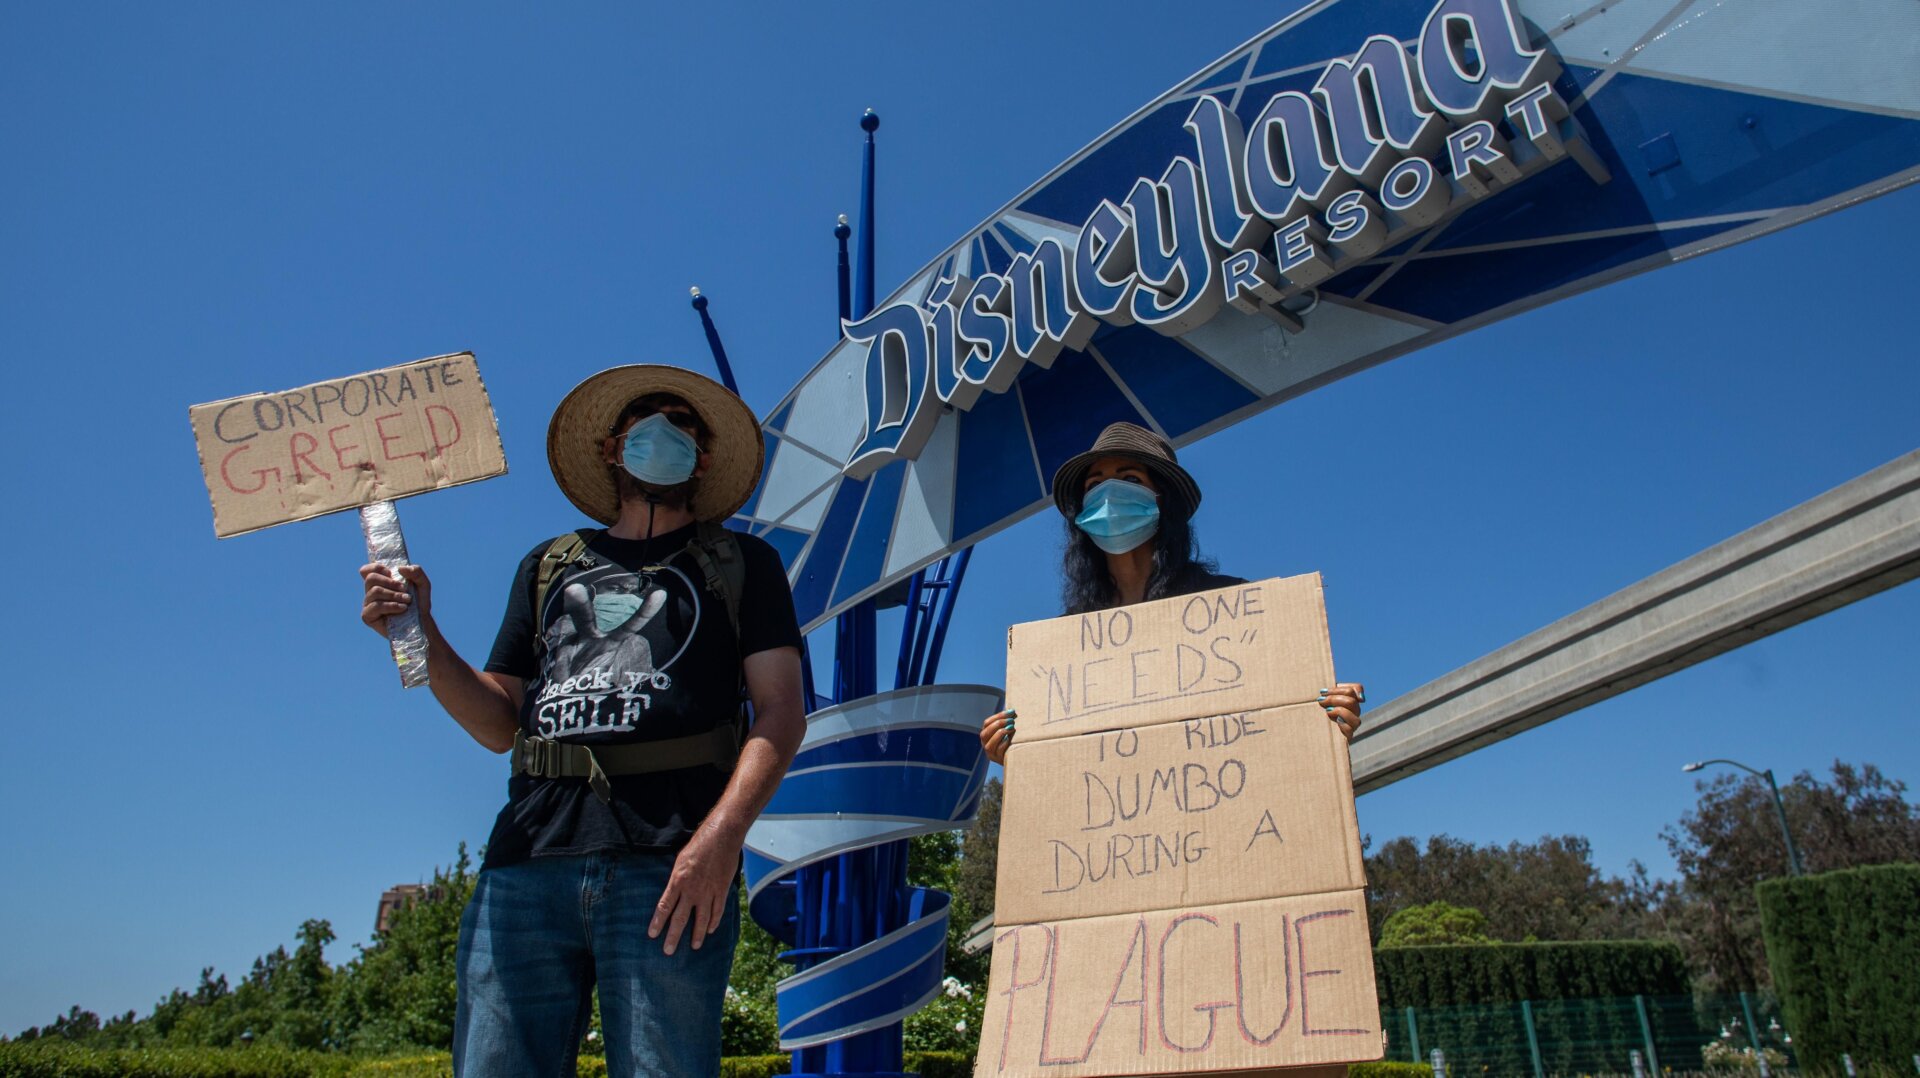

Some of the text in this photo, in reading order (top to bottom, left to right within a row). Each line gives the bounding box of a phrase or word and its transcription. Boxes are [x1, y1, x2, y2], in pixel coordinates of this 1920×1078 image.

[1222, 81, 1552, 303] RESORT
[841, 0, 1547, 477] Disneyland
[214, 361, 464, 443] CORPORATE
[220, 404, 462, 495] GREED
[1081, 587, 1265, 651] NO ONE
[538, 692, 652, 740] SELF
[622, 671, 672, 694] yo
[1031, 629, 1258, 723] "NEEDS"
[1184, 707, 1267, 750] RIDE
[1081, 758, 1247, 831] DUMBO
[1042, 808, 1284, 894] DURING A
[996, 908, 1372, 1074] PLAGUE
